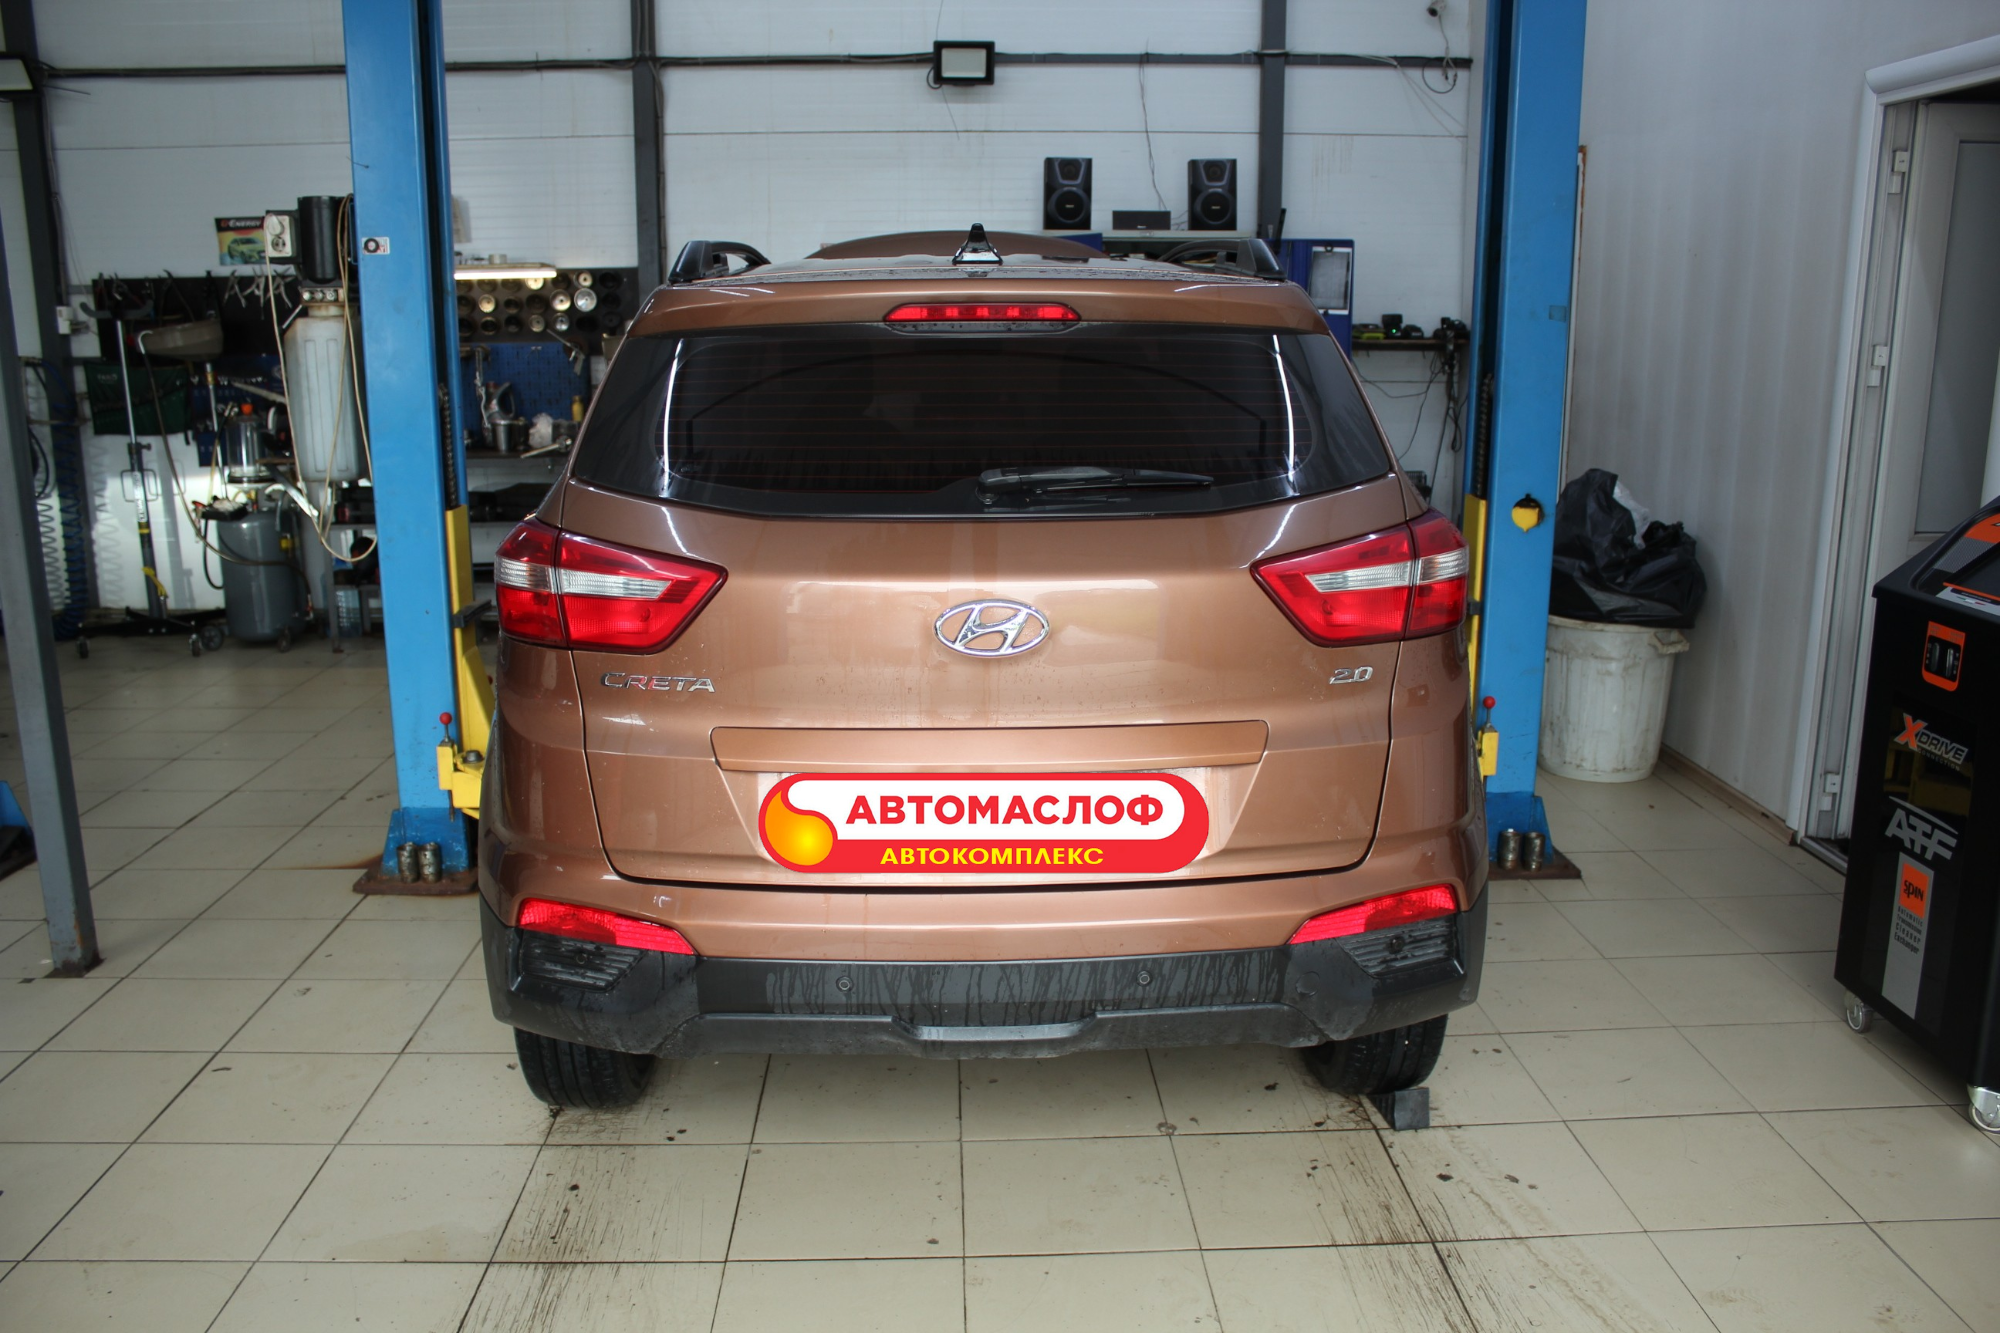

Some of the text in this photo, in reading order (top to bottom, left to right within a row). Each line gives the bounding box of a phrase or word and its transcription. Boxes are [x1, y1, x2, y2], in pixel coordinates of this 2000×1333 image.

[601, 672, 716, 693] CRETA
[1917, 747, 1960, 771] CONNECTION
[1884, 807, 1958, 861] ATF
